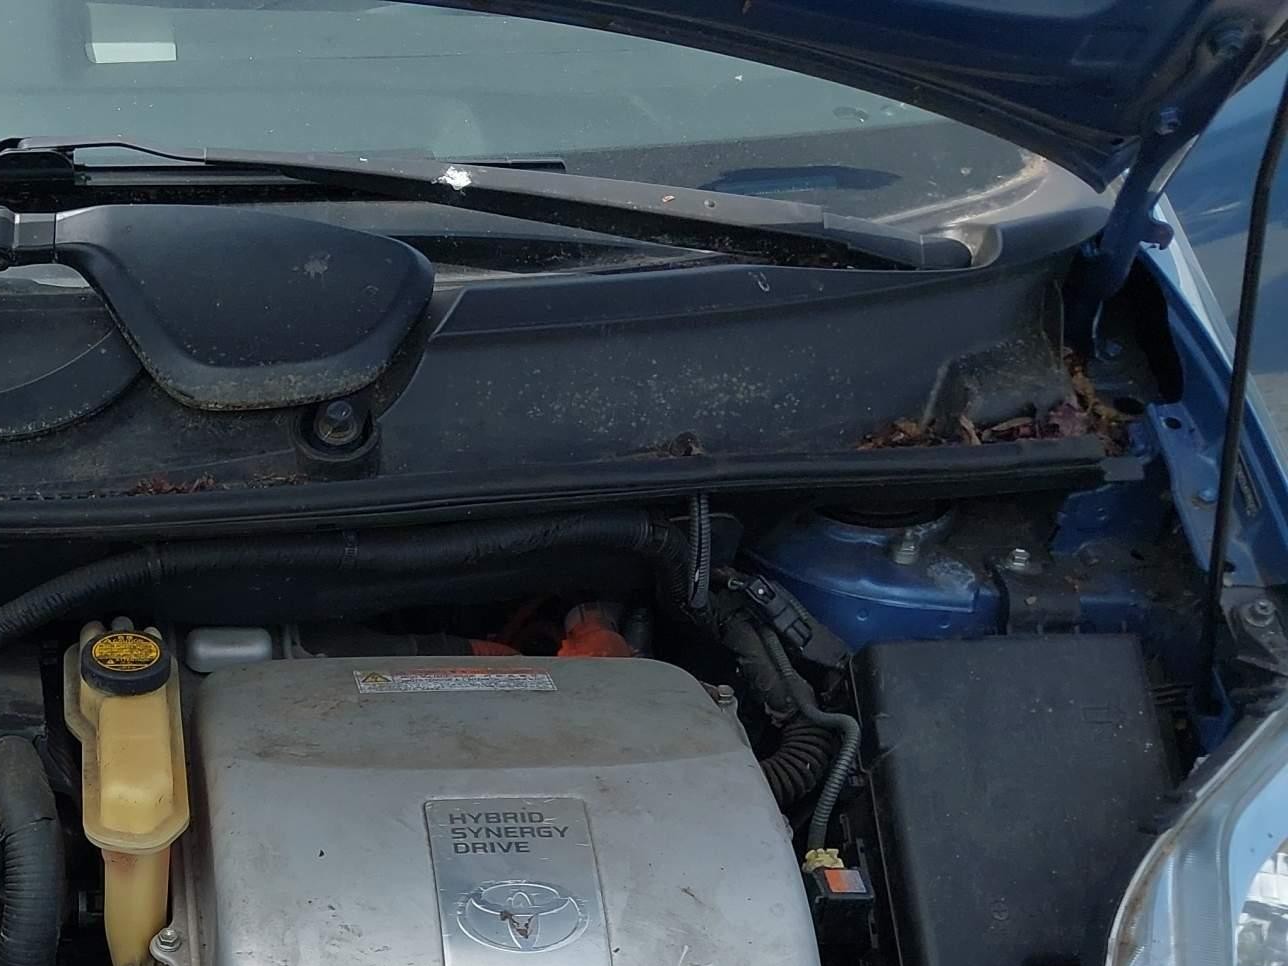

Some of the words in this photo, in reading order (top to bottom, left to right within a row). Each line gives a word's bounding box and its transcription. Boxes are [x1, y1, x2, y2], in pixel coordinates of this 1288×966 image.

[449, 812, 544, 824] HYBRID
[451, 826, 569, 839] SYNERGY
[453, 841, 531, 854] DRIVE
